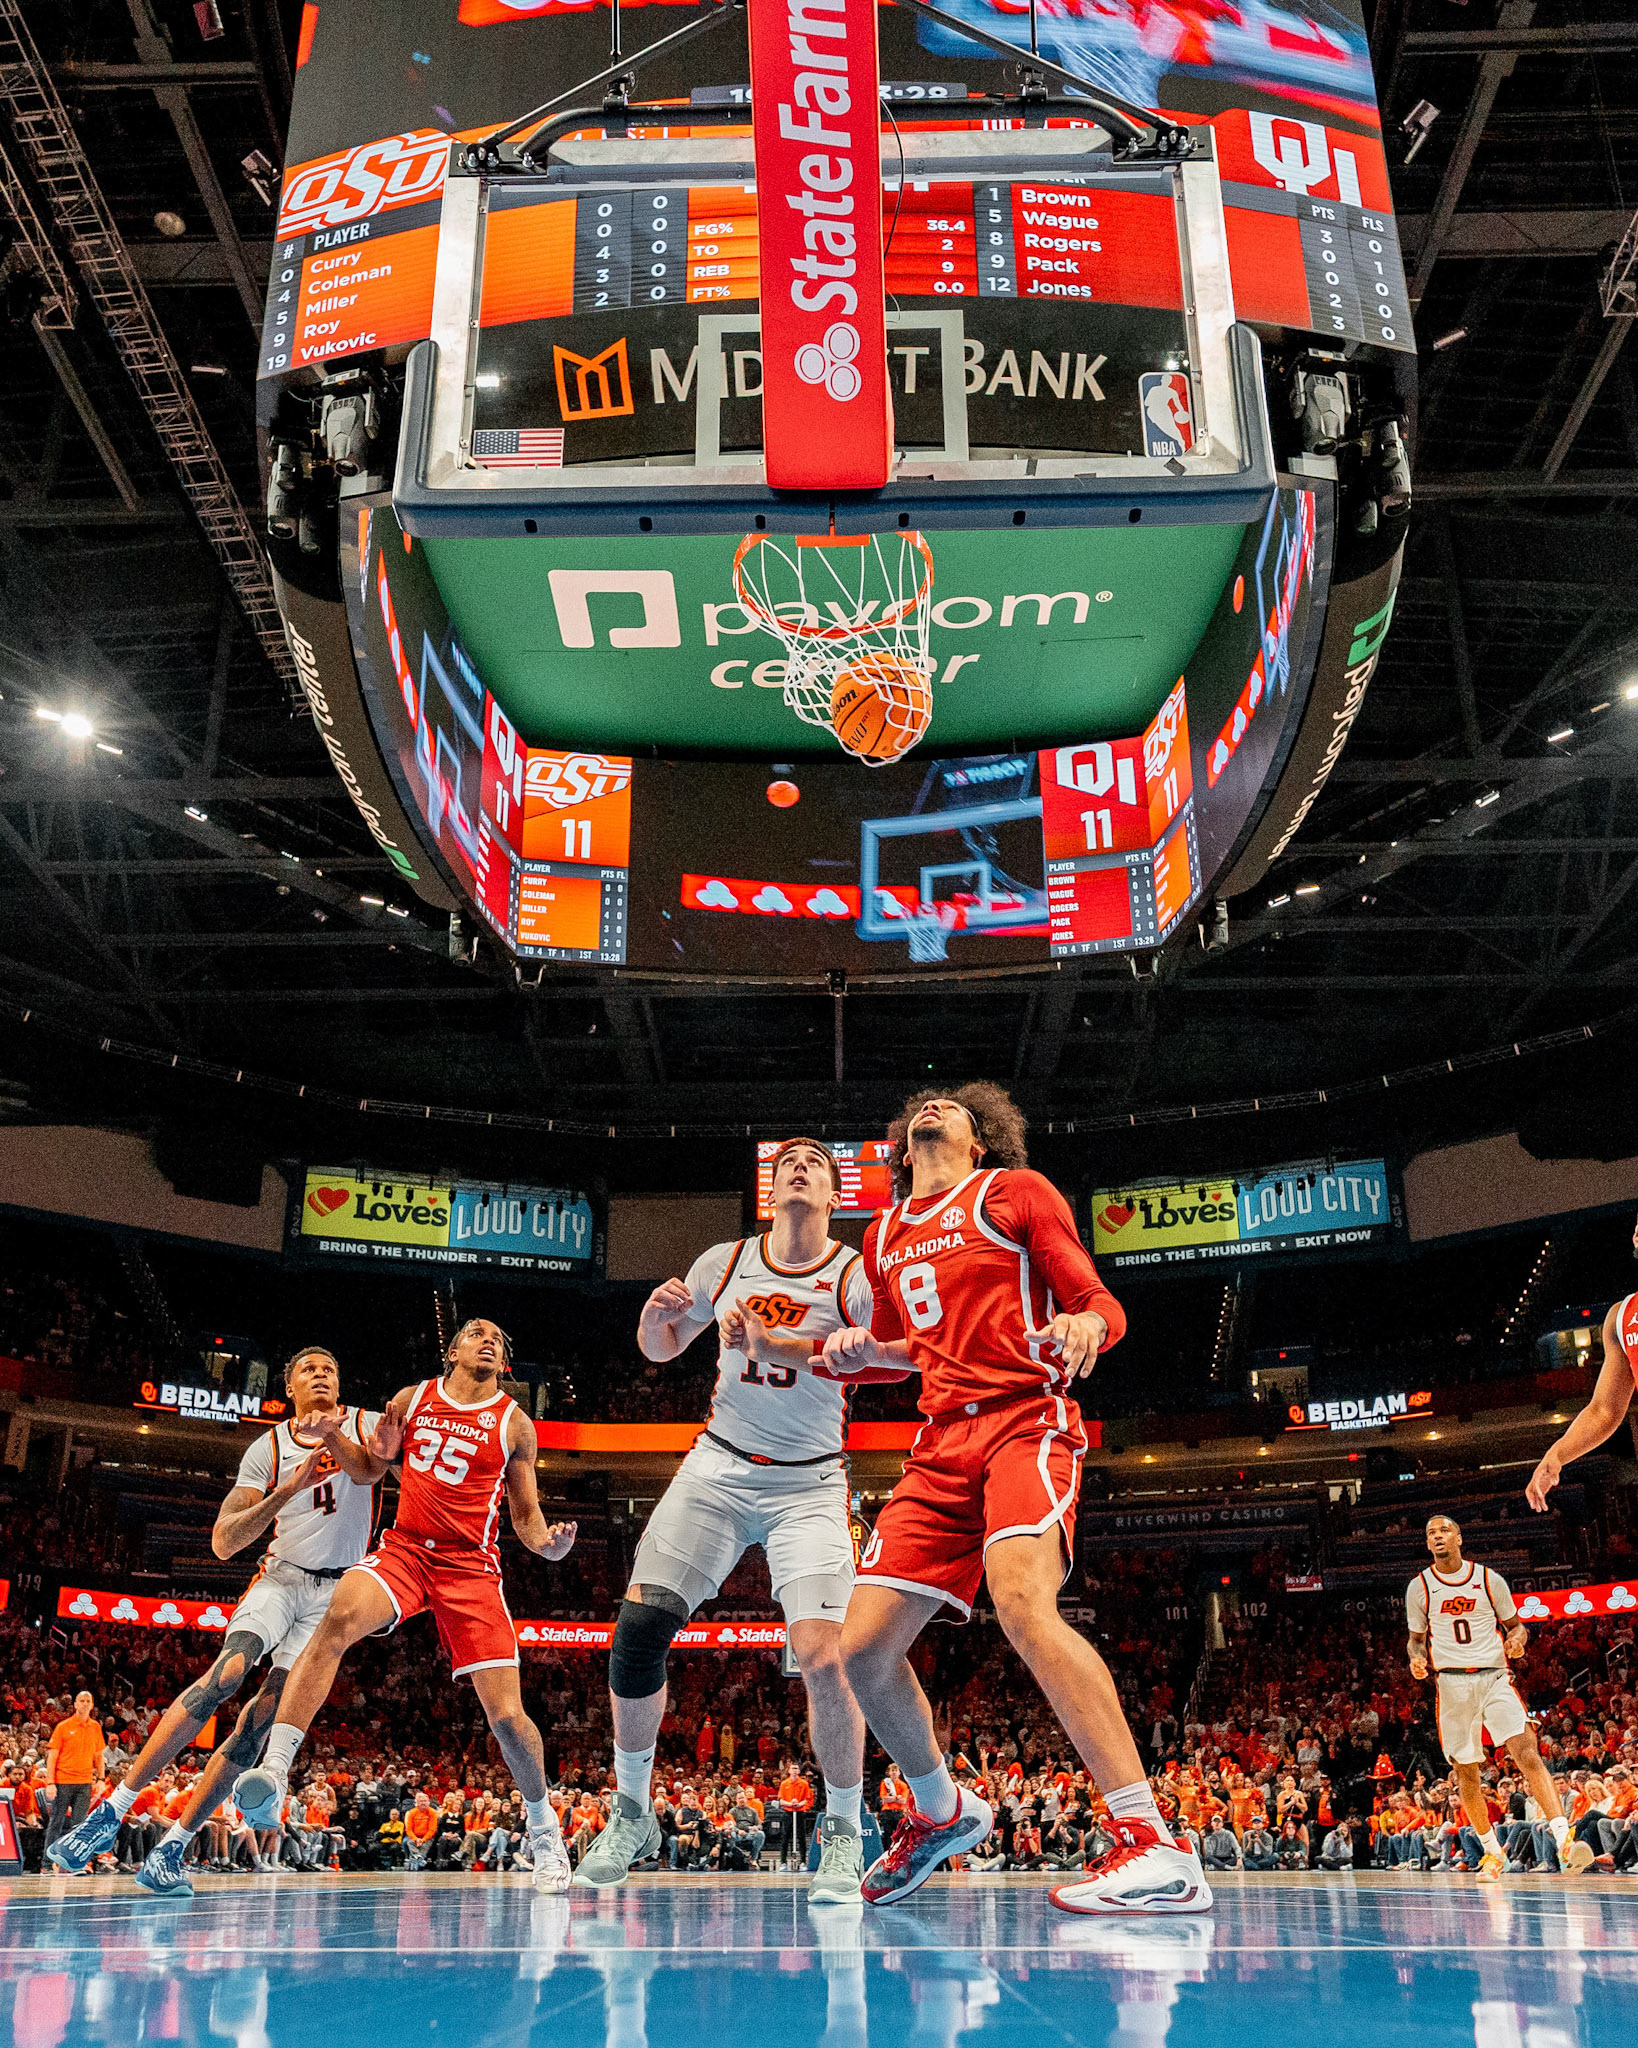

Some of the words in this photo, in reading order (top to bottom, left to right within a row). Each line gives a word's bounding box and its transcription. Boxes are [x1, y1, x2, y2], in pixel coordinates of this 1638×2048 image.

[597, 203, 613, 217] 0
[652, 195, 668, 209] 0
[988, 187, 999, 201] 1
[1021, 189, 1091, 207] Brown
[596, 224, 612, 238] 0
[652, 217, 668, 231] 0
[694, 222, 734, 236] FG%
[926, 219, 966, 232] 36.4
[988, 209, 1002, 223] 5
[1022, 210, 1099, 230] Wague
[1311, 205, 1336, 220] PTS
[1361, 216, 1385, 232] FLS
[283, 243, 294, 260] #
[313, 222, 370, 250] PLAYER
[595, 246, 610, 259] 4
[651, 240, 667, 254] 0
[693, 244, 719, 256] TO
[941, 238, 954, 251] 2
[989, 231, 1004, 245] 8
[1024, 233, 1102, 252] Rogers
[1320, 230, 1333, 243] 3
[1368, 240, 1382, 254] 0
[281, 269, 295, 283] 0
[310, 251, 362, 274] Curry
[596, 268, 610, 283] 3
[650, 263, 666, 277] 0
[693, 264, 730, 278] REB
[941, 261, 954, 273] 9
[990, 254, 1005, 268] 9
[1026, 256, 1080, 274] Pack
[1322, 250, 1336, 263] 0
[1373, 261, 1383, 275] 1
[278, 289, 291, 303] 4
[308, 264, 393, 294] Coleman
[693, 285, 731, 299] FT%
[933, 281, 965, 293] 0.0
[987, 277, 1011, 292] 12
[1026, 279, 1092, 297] Jones
[1325, 271, 1339, 285] 0
[1375, 282, 1389, 297] 0
[595, 292, 609, 306] 2
[650, 285, 666, 300] 0
[1329, 293, 1342, 308] 2
[1378, 304, 1392, 319] 0
[276, 311, 289, 325] 5
[305, 294, 359, 317] Miller
[273, 333, 286, 347] 9
[303, 320, 341, 339] Roy
[1332, 315, 1345, 330] 3
[1381, 326, 1396, 340] 0
[266, 353, 288, 371] 19
[300, 332, 377, 360] Vukovic
[962, 338, 1108, 402] BANK
[1152, 441, 1177, 456] NBA
[1313, 655, 1375, 784] paycom
[323, 733, 398, 848] paycom
[1163, 767, 1179, 818] 11
[496, 780, 509, 833] 11
[561, 818, 592, 859] 11
[1080, 808, 1113, 850] 11
[524, 863, 551, 874] PLAYER
[600, 870, 615, 879] PTS
[616, 871, 625, 880] FL
[1049, 862, 1075, 872] PLAYER
[1125, 854, 1139, 863] PTS
[1141, 852, 1151, 861] FL
[522, 877, 548, 886] CURRY
[1048, 876, 1075, 885] BROWN
[522, 890, 556, 900] COLEMAN
[1049, 890, 1074, 899] WAGUE
[521, 904, 547, 914] MILLER
[1050, 903, 1079, 913] ROGERS
[521, 917, 536, 926] ROY
[1051, 918, 1071, 927] PACK
[520, 932, 551, 942] VUKOVIC
[1052, 931, 1074, 941] JONES
[1058, 946, 1067, 955] TO
[1081, 944, 1090, 952] TF
[1112, 940, 1126, 949] 1ST
[1134, 937, 1155, 946] 13:28
[524, 946, 534, 955] TO
[548, 948, 557, 957] TF
[579, 951, 592, 959] 1ST
[600, 952, 620, 961] 13:28
[1244, 1179, 1312, 1231] LOUD
[1321, 1176, 1381, 1215] CITY
[456, 1200, 522, 1240] LOUD
[532, 1202, 587, 1249] CITY
[319, 1240, 368, 1254] BRING
[371, 1244, 402, 1257] THE
[406, 1248, 478, 1263] THUNDER
[500, 1255, 535, 1267] EXIT
[538, 1259, 572, 1271] NOW
[880, 1232, 966, 1272] OKLAHOMA
[1115, 1252, 1161, 1267] BRING
[1165, 1249, 1195, 1262] THE
[1199, 1241, 1272, 1259] THUNDER
[1295, 1235, 1331, 1248] EXIT
[1334, 1230, 1372, 1244] NOW
[899, 1261, 944, 1330] 8
[745, 1292, 811, 1330] OSU
[160, 1384, 261, 1416] BEDLAM
[1307, 1392, 1408, 1423] BEDLAM
[180, 1407, 240, 1423] BASKETBALL
[1330, 1416, 1390, 1431] BASKETBALL
[415, 1416, 489, 1445] OKLAHOMA
[408, 1427, 478, 1485] 35
[313, 1480, 337, 1517] 4
[1116, 1511, 1211, 1527] RIVERWIND
[1220, 1507, 1285, 1520] CASINO
[1242, 1602, 1268, 1617] 102
[1440, 1595, 1477, 1616] OSU
[540, 1627, 609, 1642] StateFarm
[1453, 1619, 1472, 1645] 0
